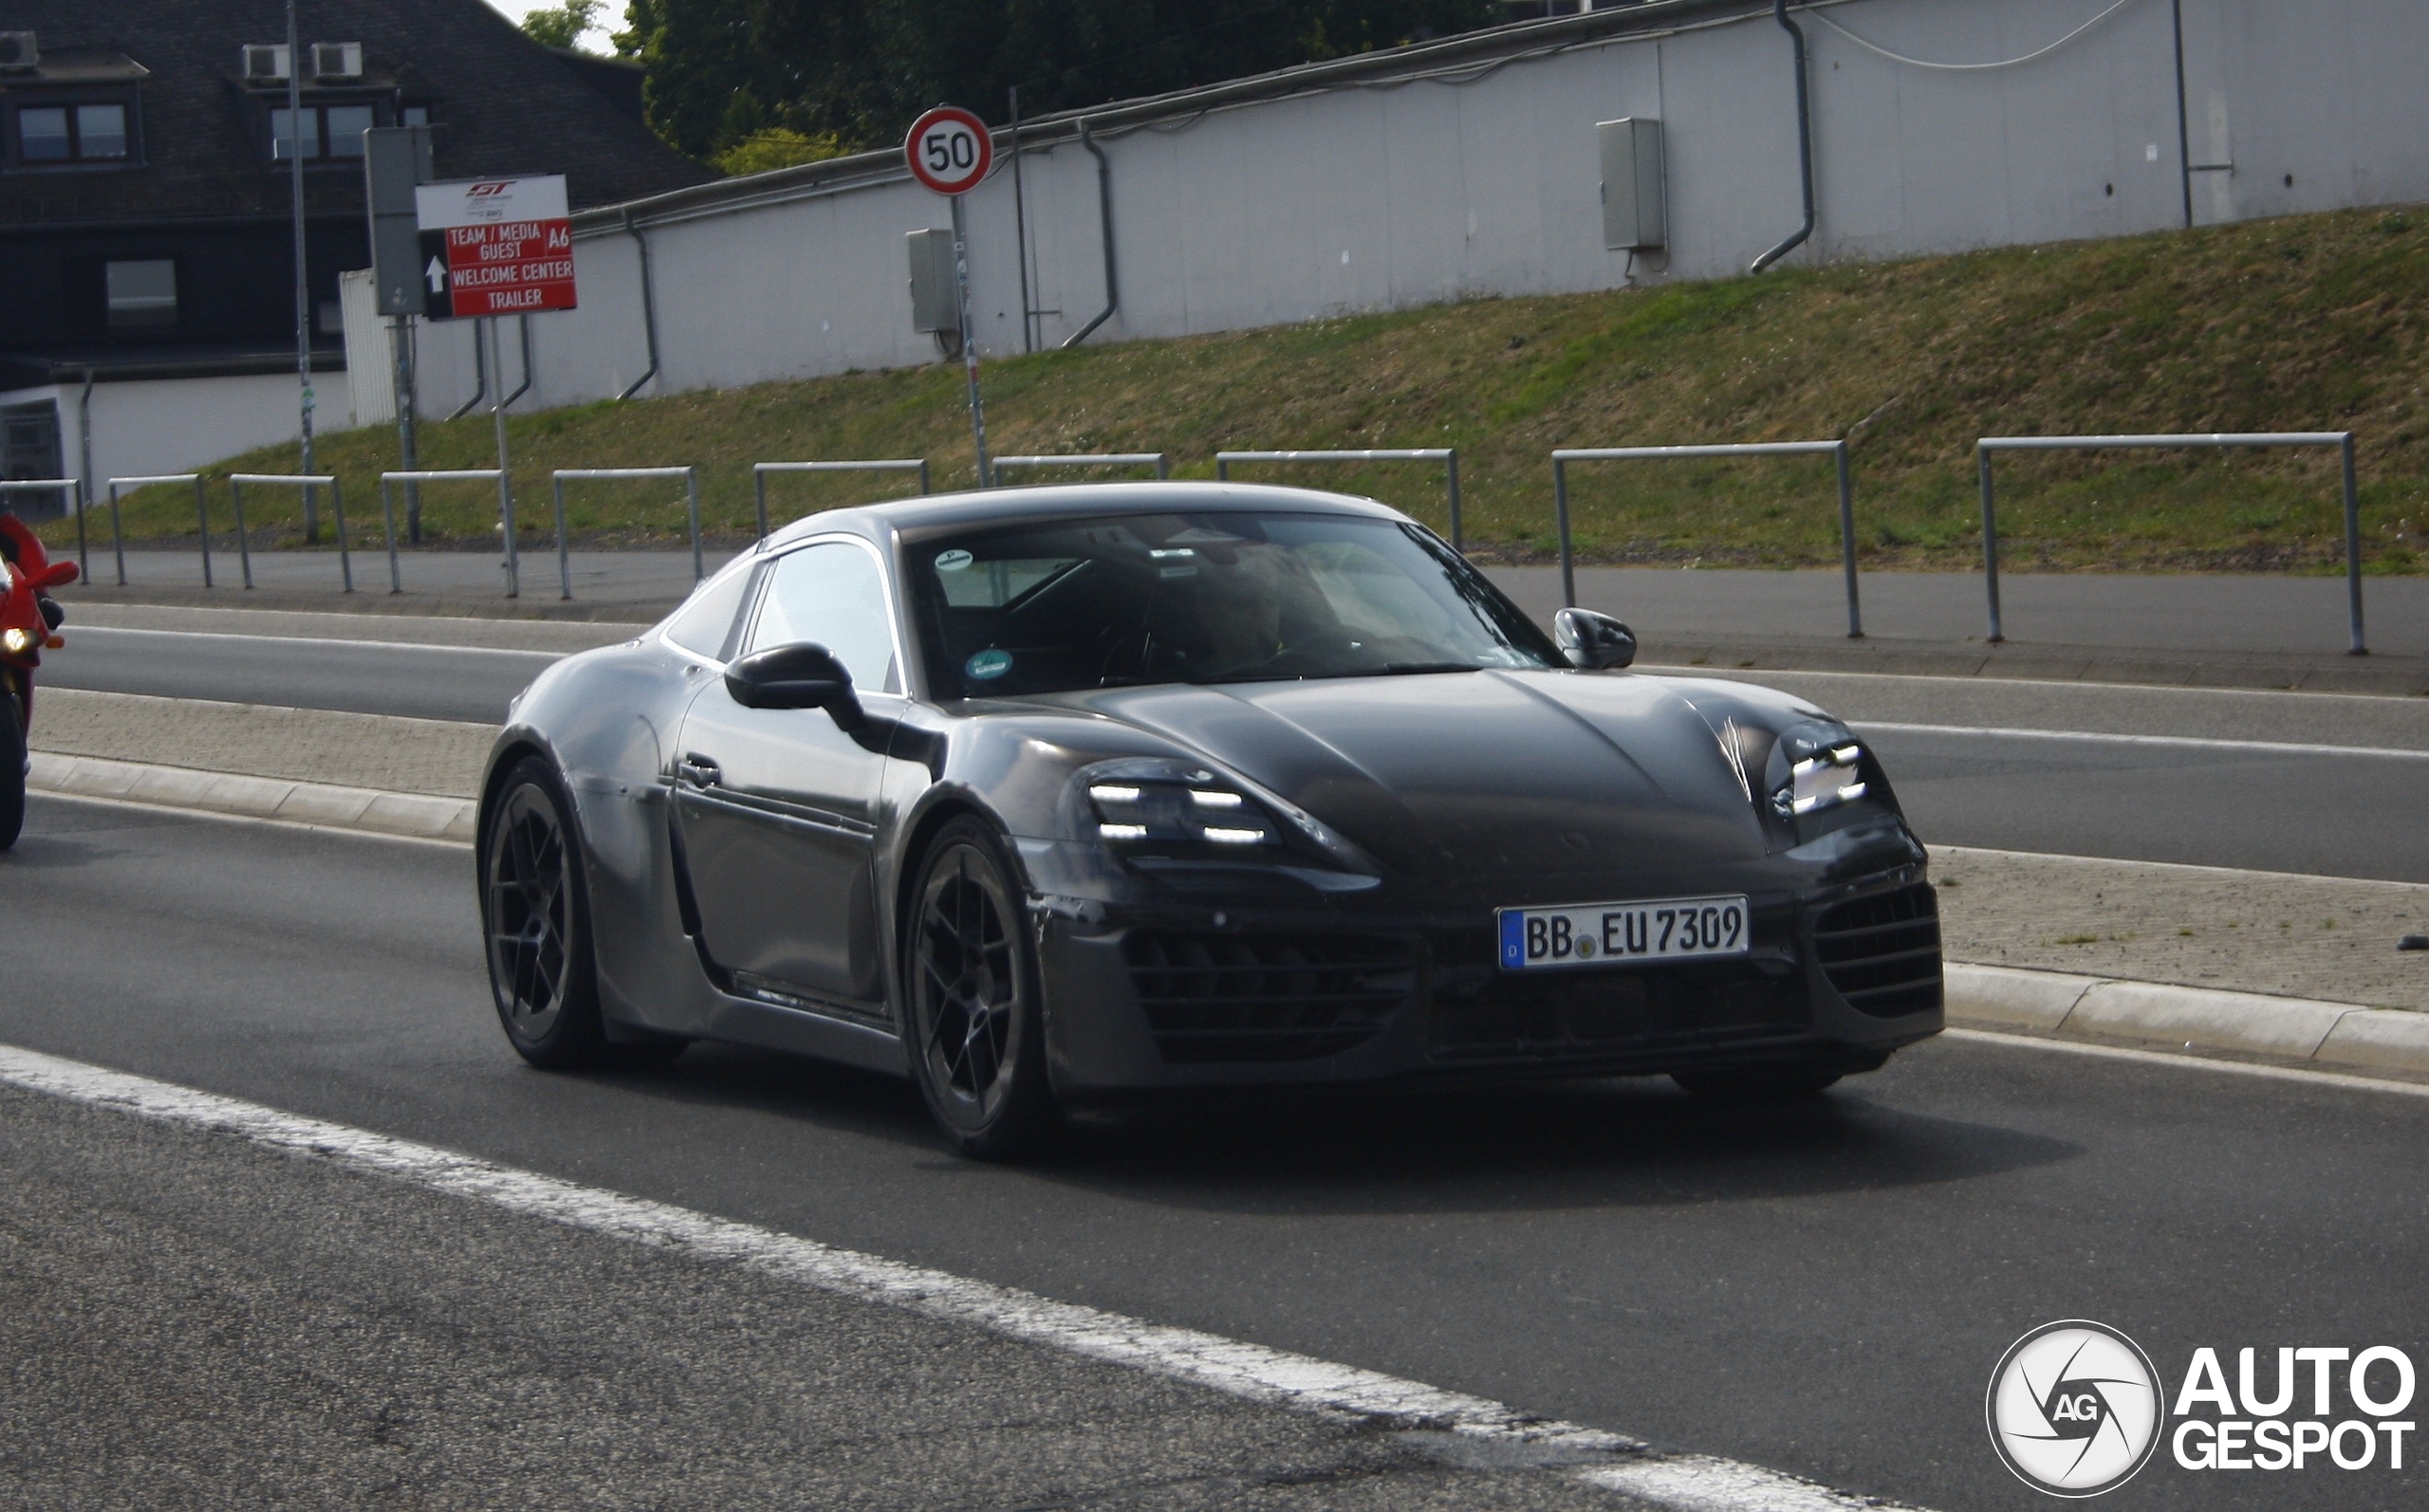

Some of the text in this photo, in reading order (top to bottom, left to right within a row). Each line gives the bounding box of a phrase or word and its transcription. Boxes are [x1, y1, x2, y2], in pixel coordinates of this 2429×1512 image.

[927, 131, 974, 172] 50
[451, 223, 541, 245] TEAM / MEDIA
[548, 227, 569, 249] A6
[480, 241, 523, 261] GUEST
[453, 261, 573, 286] WELCOME CENTER
[489, 289, 543, 309] TRAILER
[1508, 945, 1517, 957] D
[1527, 914, 1572, 959] BB
